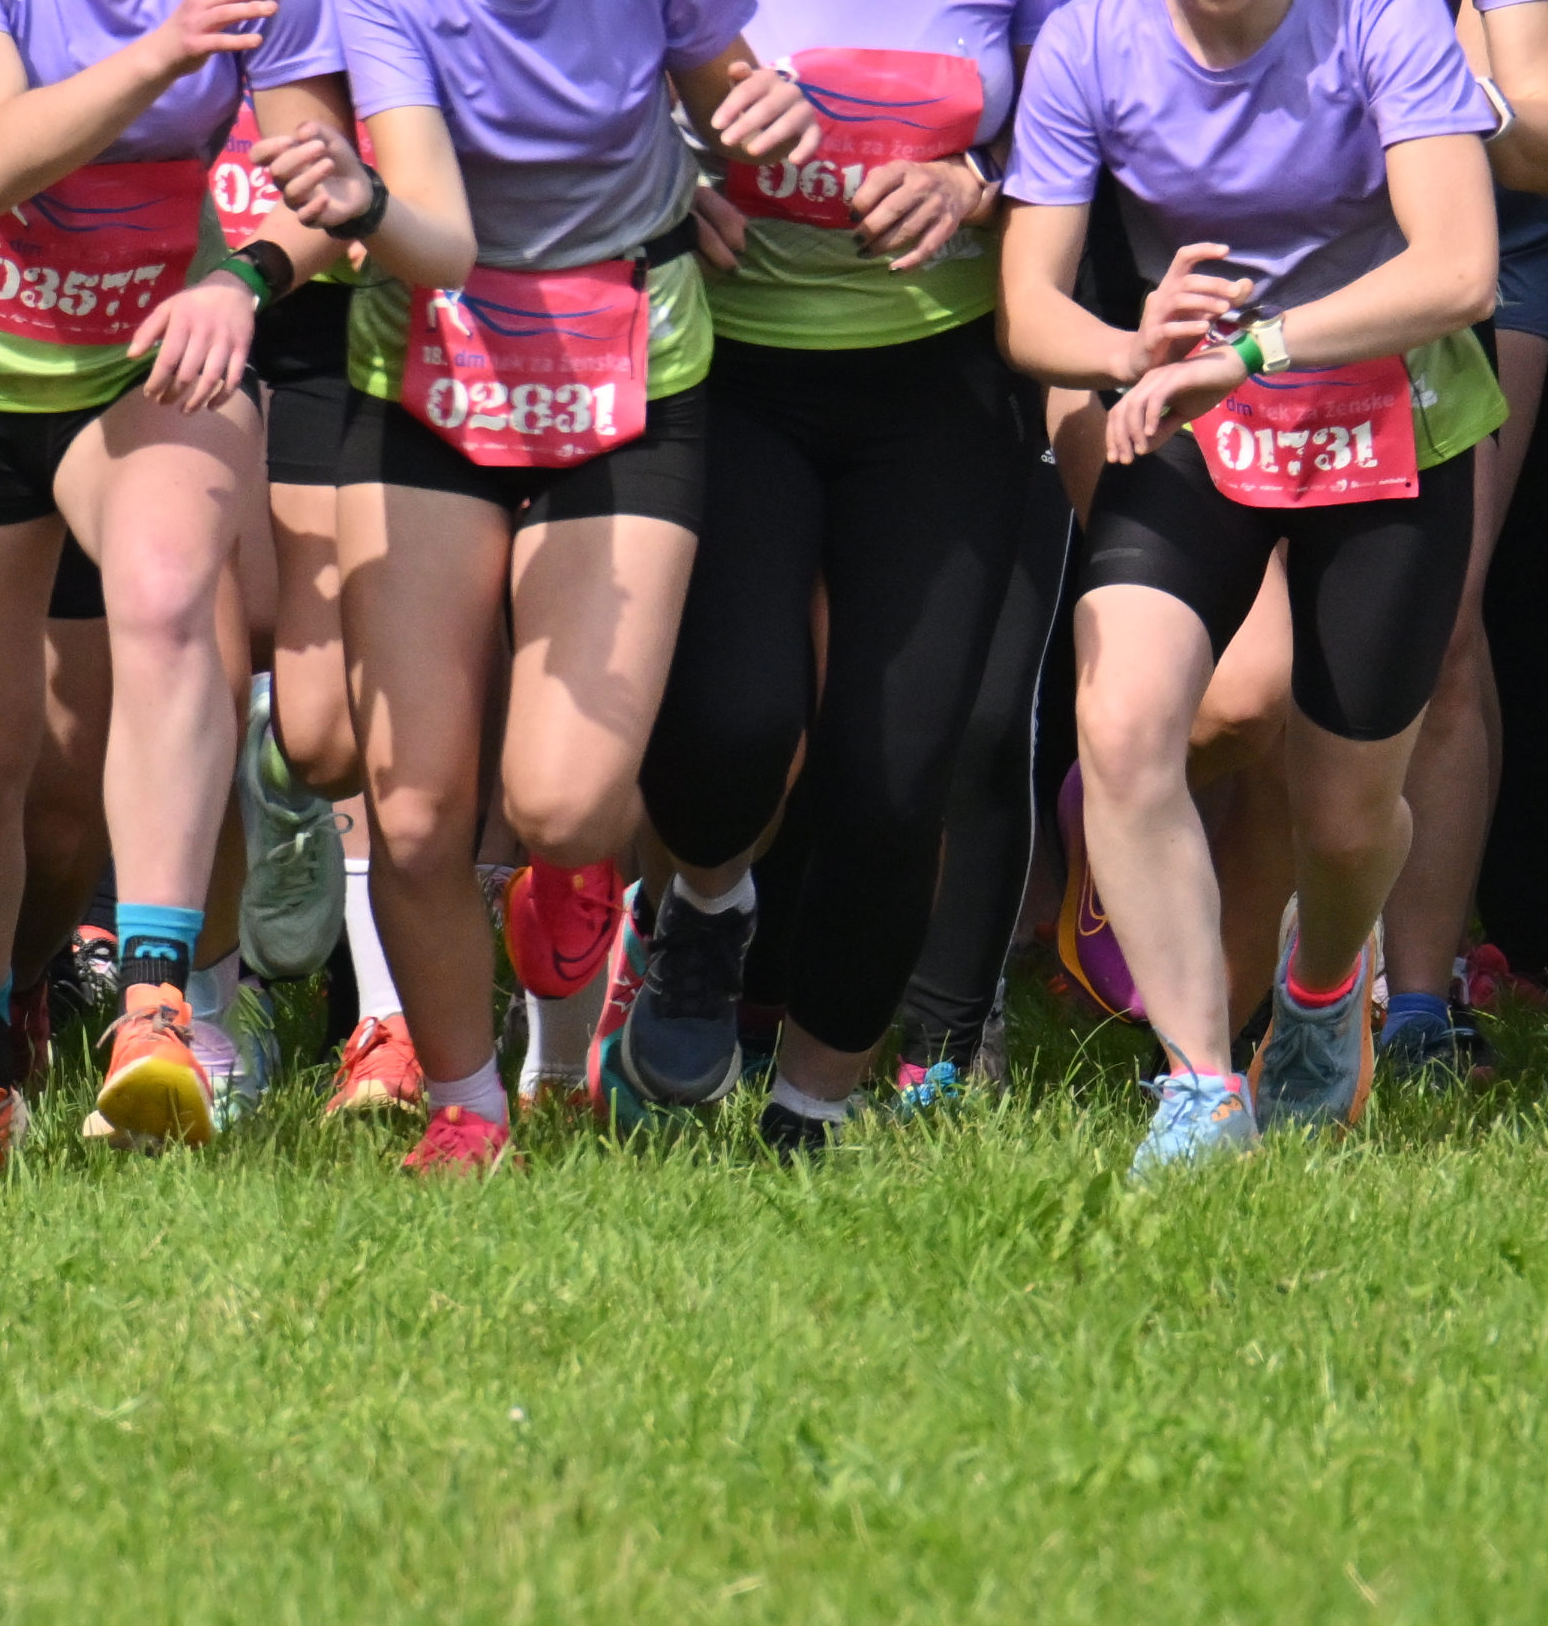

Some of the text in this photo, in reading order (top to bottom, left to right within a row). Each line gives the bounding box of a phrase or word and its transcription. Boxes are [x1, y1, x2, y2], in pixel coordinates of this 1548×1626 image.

[756, 157, 865, 206] 061
[455, 350, 486, 368] dm
[426, 377, 617, 435] 02831
[1226, 396, 1252, 416] dm
[1258, 403, 1290, 421] tek
[1325, 394, 1395, 419] ženske
[1216, 421, 1378, 476] 01731
